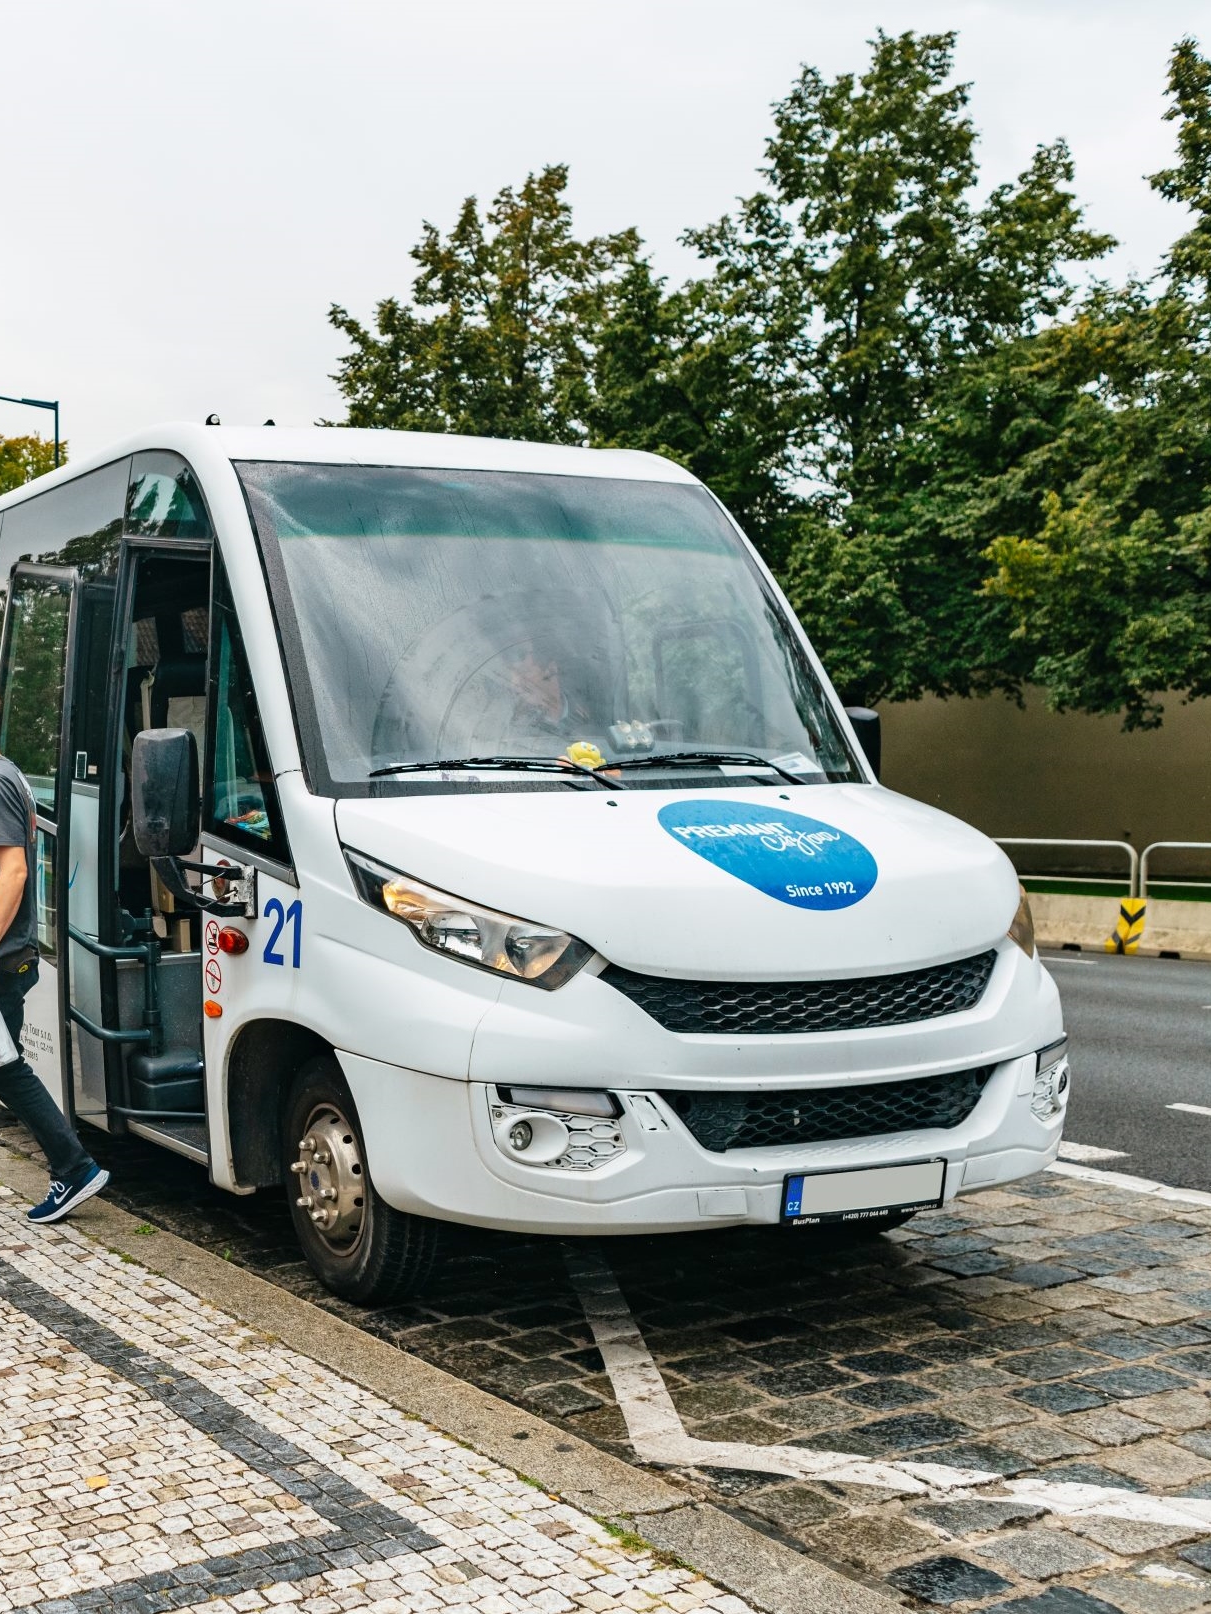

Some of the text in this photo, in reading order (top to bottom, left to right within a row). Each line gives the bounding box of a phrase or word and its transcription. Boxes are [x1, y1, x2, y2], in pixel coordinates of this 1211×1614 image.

[671, 822, 793, 839] PREMIANT
[785, 881, 856, 898] Since 1992
[263, 897, 303, 969] 21
[787, 1201, 800, 1211] CZ
[792, 1217, 821, 1226] BusPlan
[900, 1203, 938, 1214] www.busplan.cz
